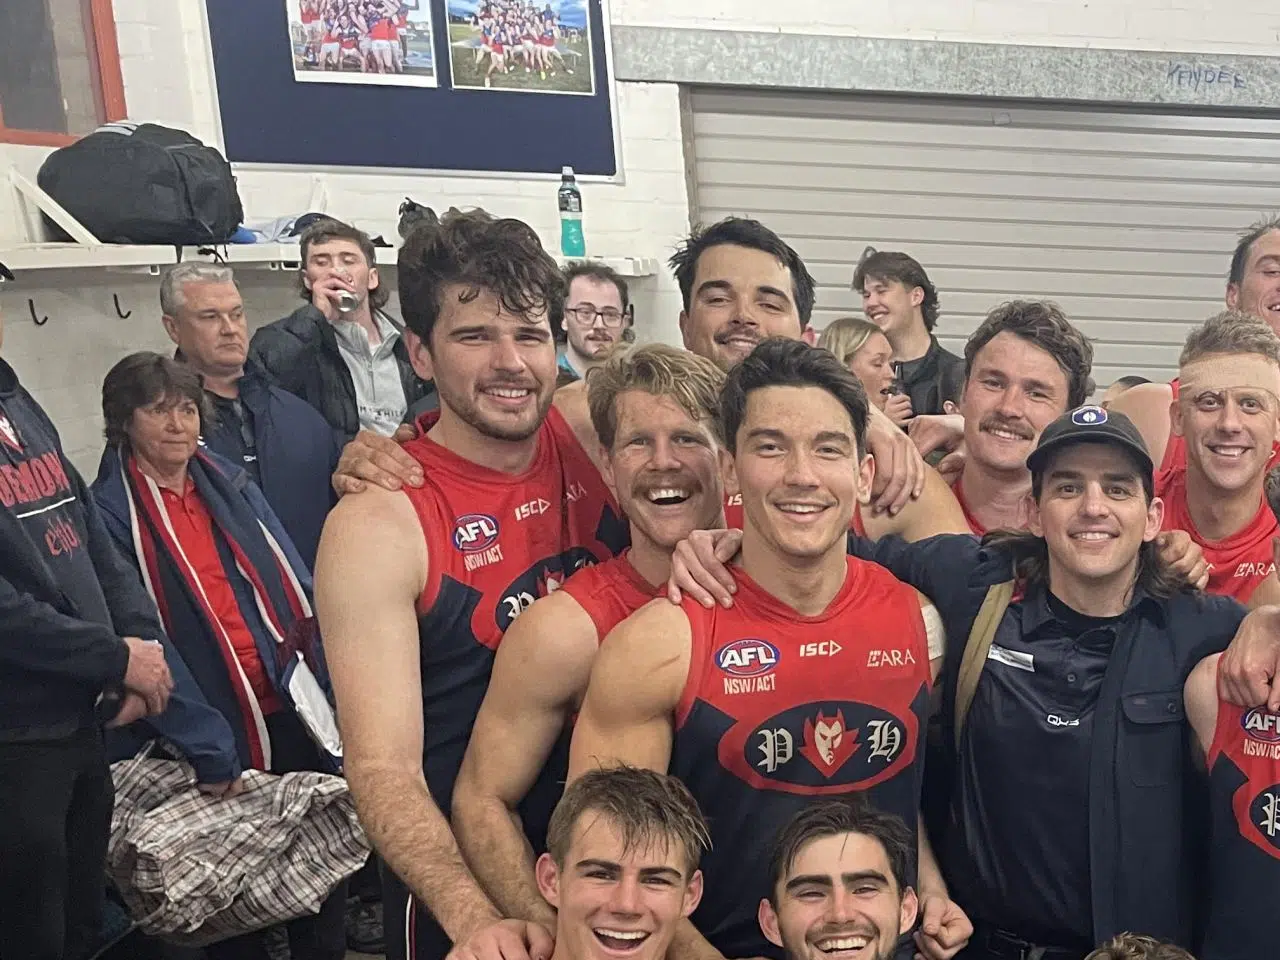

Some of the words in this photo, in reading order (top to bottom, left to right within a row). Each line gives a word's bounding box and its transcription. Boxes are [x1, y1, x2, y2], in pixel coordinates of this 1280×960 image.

[457, 520, 498, 550] AFL
[720, 646, 776, 668] AFL
[724, 674, 776, 695] NSW/ACT
